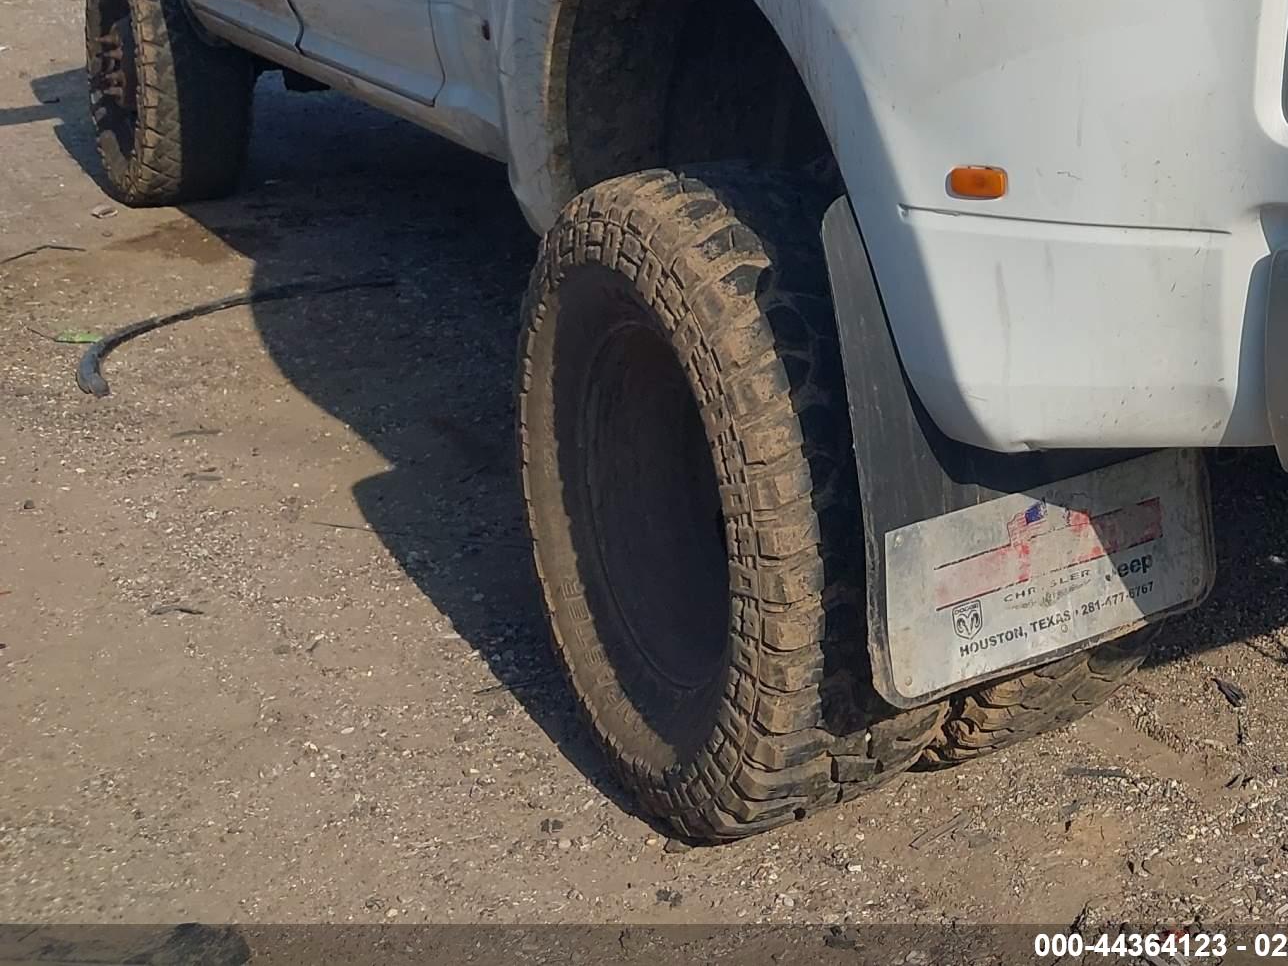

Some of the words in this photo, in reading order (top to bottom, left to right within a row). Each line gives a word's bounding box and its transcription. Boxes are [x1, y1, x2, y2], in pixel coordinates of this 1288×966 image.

[1003, 569, 1092, 602] CHRSLER
[959, 625, 1028, 658] HOUSTON,
[1030, 609, 1071, 633] TEXAS
